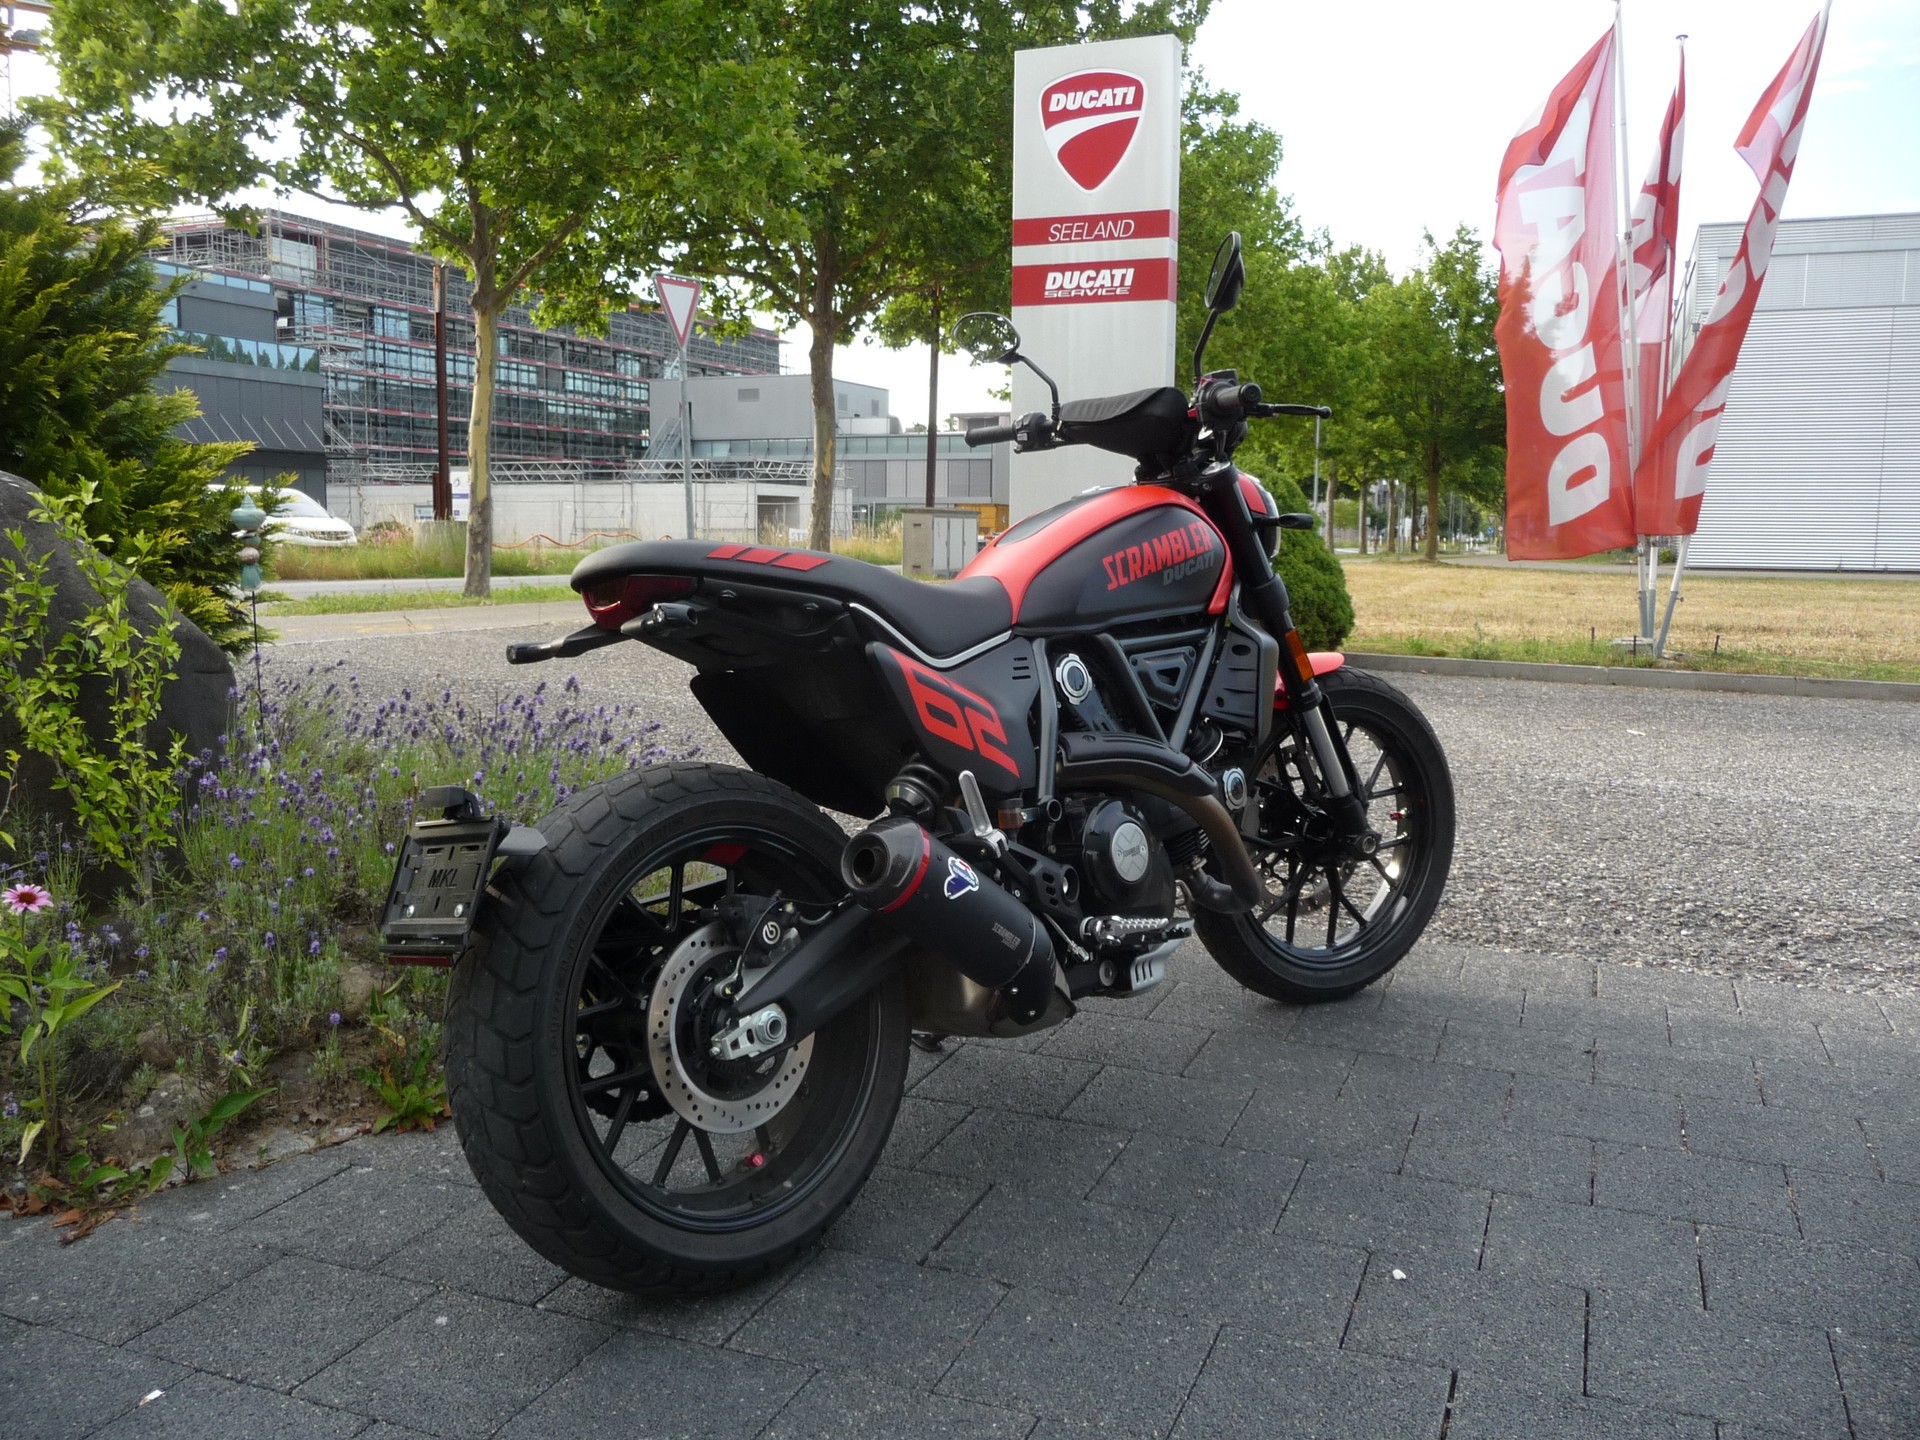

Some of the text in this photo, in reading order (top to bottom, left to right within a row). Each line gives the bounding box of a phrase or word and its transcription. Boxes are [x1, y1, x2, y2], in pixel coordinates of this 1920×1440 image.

[1049, 86, 1136, 112] DUCATI
[1048, 219, 1135, 242] SEELAND
[1045, 268, 1135, 290] DUCATI
[1044, 287, 1130, 298] SERVICE
[1102, 521, 1214, 592] SCRAMBLER
[1163, 551, 1216, 586] DUCATI
[428, 868, 459, 888] MKL
